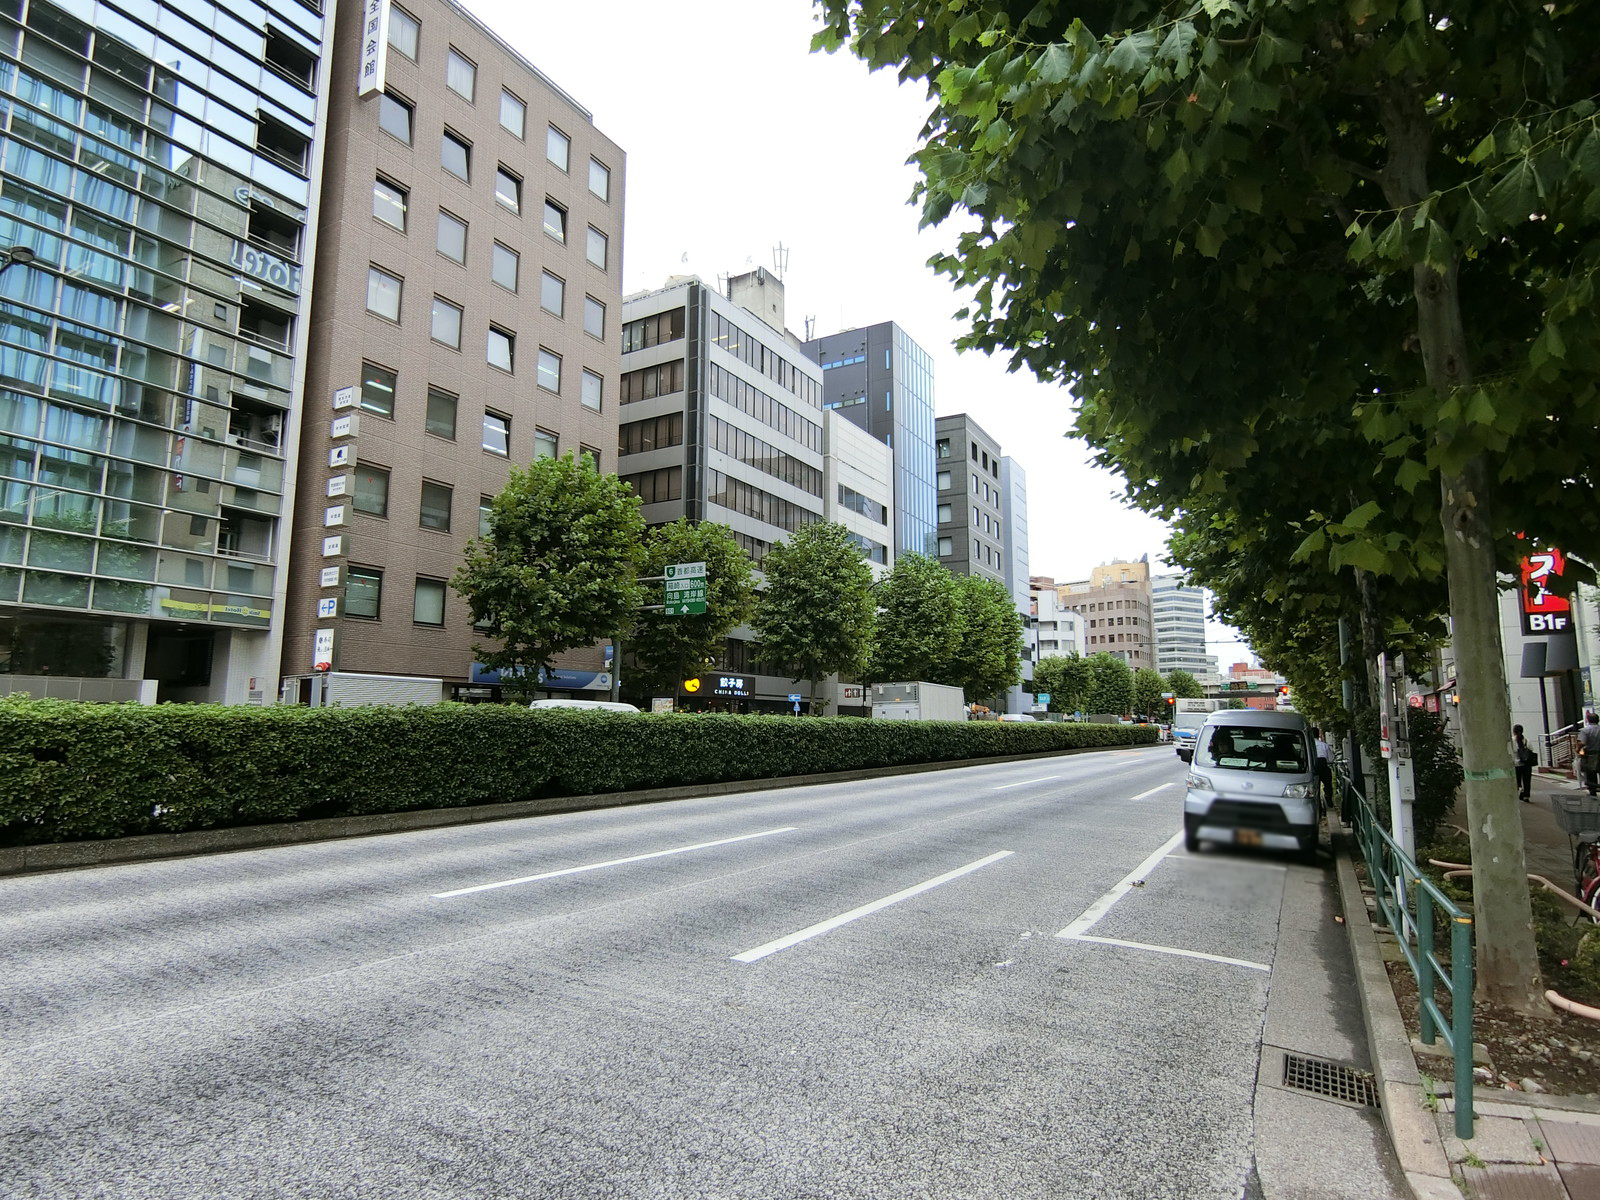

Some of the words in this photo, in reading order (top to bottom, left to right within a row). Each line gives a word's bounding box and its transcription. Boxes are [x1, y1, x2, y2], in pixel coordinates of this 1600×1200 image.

[677, 565, 704, 576] 首都高速
[328, 600, 336, 615] P
[1529, 613, 1567, 631] B1F
